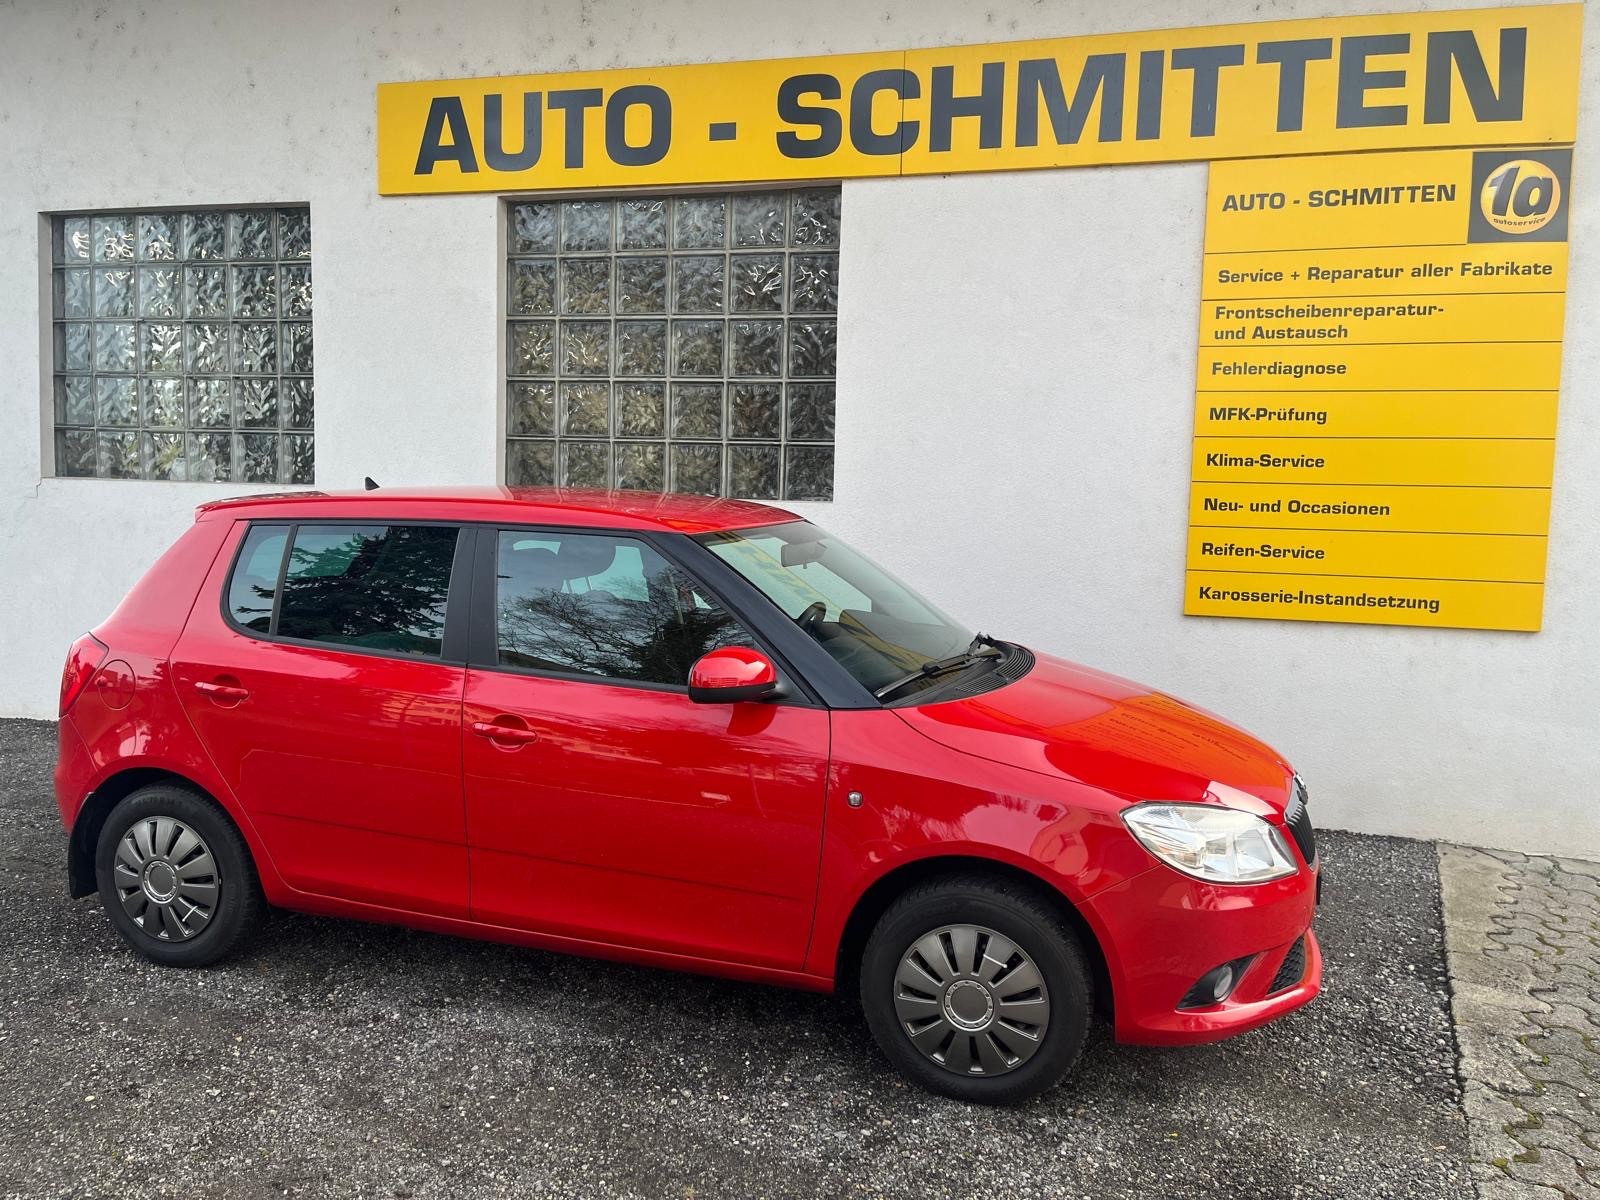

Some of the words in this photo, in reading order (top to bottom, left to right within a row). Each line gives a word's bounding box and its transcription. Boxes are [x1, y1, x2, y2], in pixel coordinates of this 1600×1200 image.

[414, 85, 671, 174] AUTO
[709, 122, 737, 142] -
[777, 28, 1527, 159] SCHMITTEN
[1222, 193, 1285, 212] AUTO
[1309, 184, 1456, 208] SCHMITTEN
[1488, 166, 1553, 218] 1a
[1492, 217, 1546, 227] autoservice
[1218, 269, 1284, 283] Service
[1290, 271, 1300, 281] +
[1308, 266, 1404, 283] Reparatur
[1411, 263, 1453, 278] aller
[1461, 262, 1553, 277] Fabrikate
[1215, 304, 1444, 320] Frontscheibenreparatur-
[1214, 328, 1246, 340] und
[1252, 326, 1348, 340] Austausch
[1212, 361, 1347, 379] Fehlerdiagnose
[1209, 407, 1327, 425] MFK-Prüfung
[1206, 453, 1325, 468] Klima-Service
[1204, 498, 1244, 512] Neu-
[1249, 499, 1281, 513] und
[1287, 499, 1390, 516] Occasionen
[1201, 542, 1325, 560] Reifen-Service
[1199, 586, 1440, 614] Karosserie-Instandsetzung
